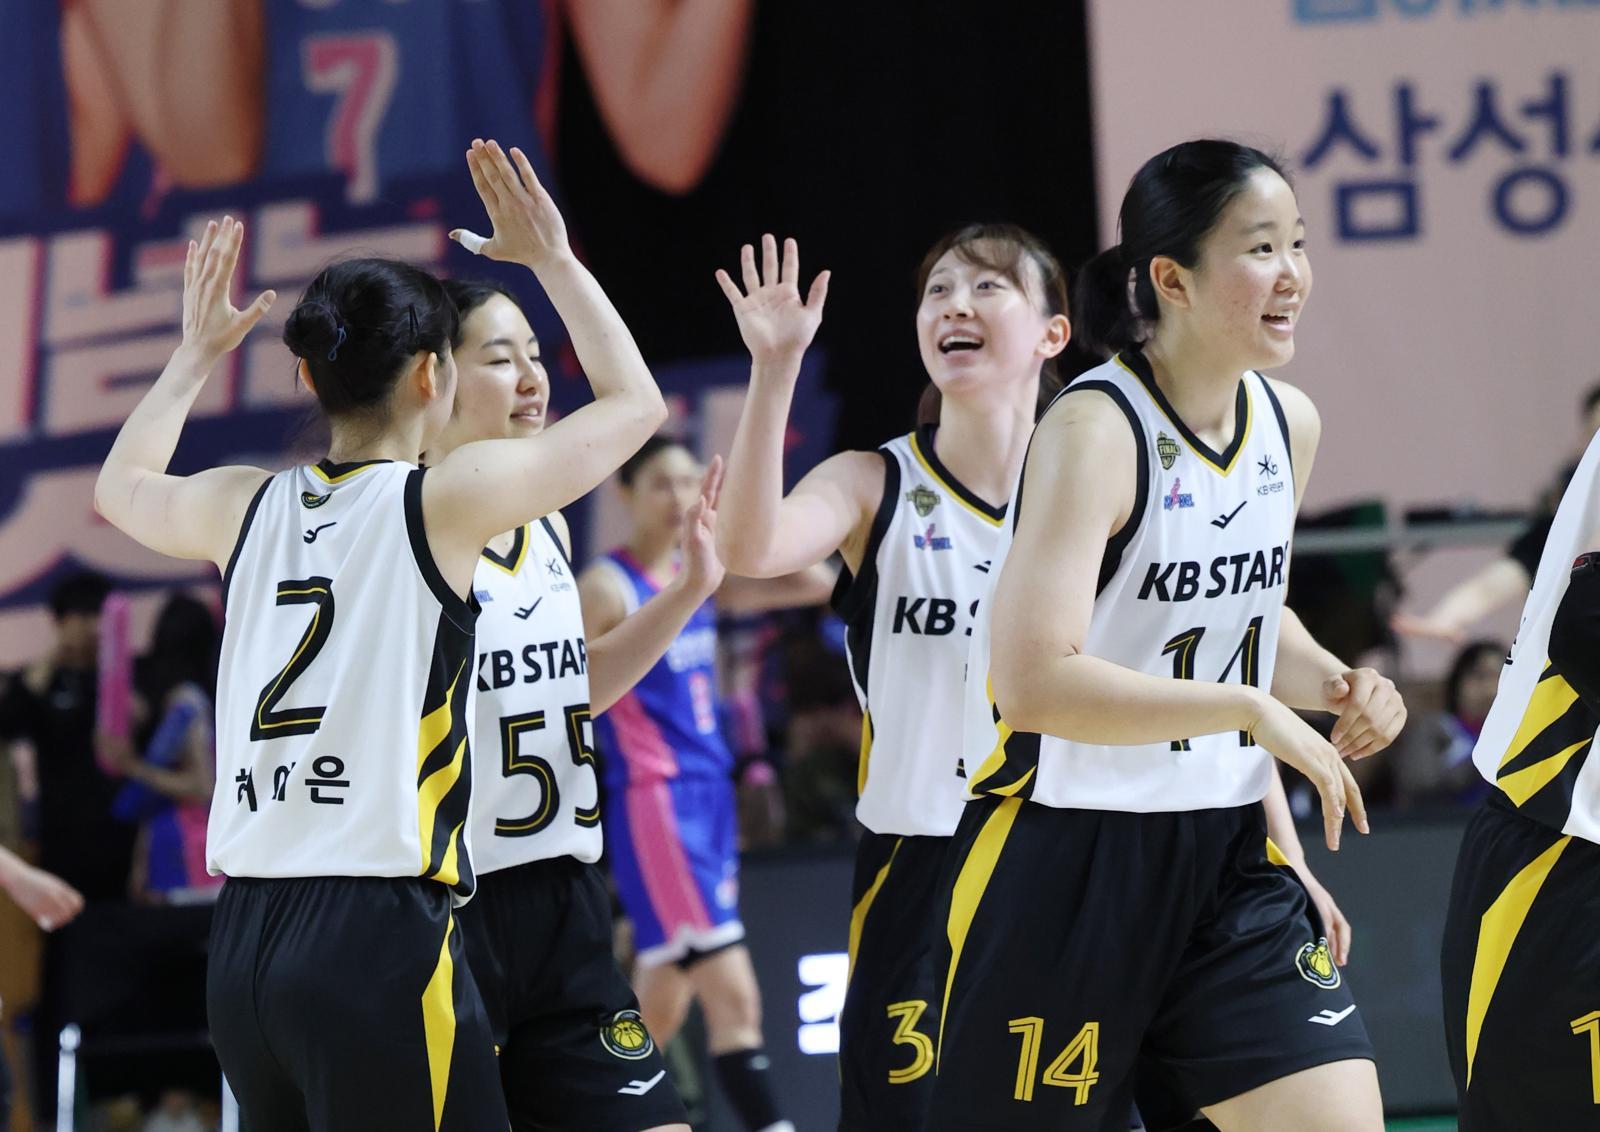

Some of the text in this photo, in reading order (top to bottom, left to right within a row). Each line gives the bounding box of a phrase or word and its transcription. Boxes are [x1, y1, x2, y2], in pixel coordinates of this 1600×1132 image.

[304, 34, 395, 202] 7
[1302, 70, 1600, 242] 삼성
[892, 596, 957, 636] KB
[1137, 541, 1289, 602] KB STAR
[250, 576, 335, 742] 2
[886, 1000, 934, 1084] 3
[1008, 1016, 1099, 1106] 14
